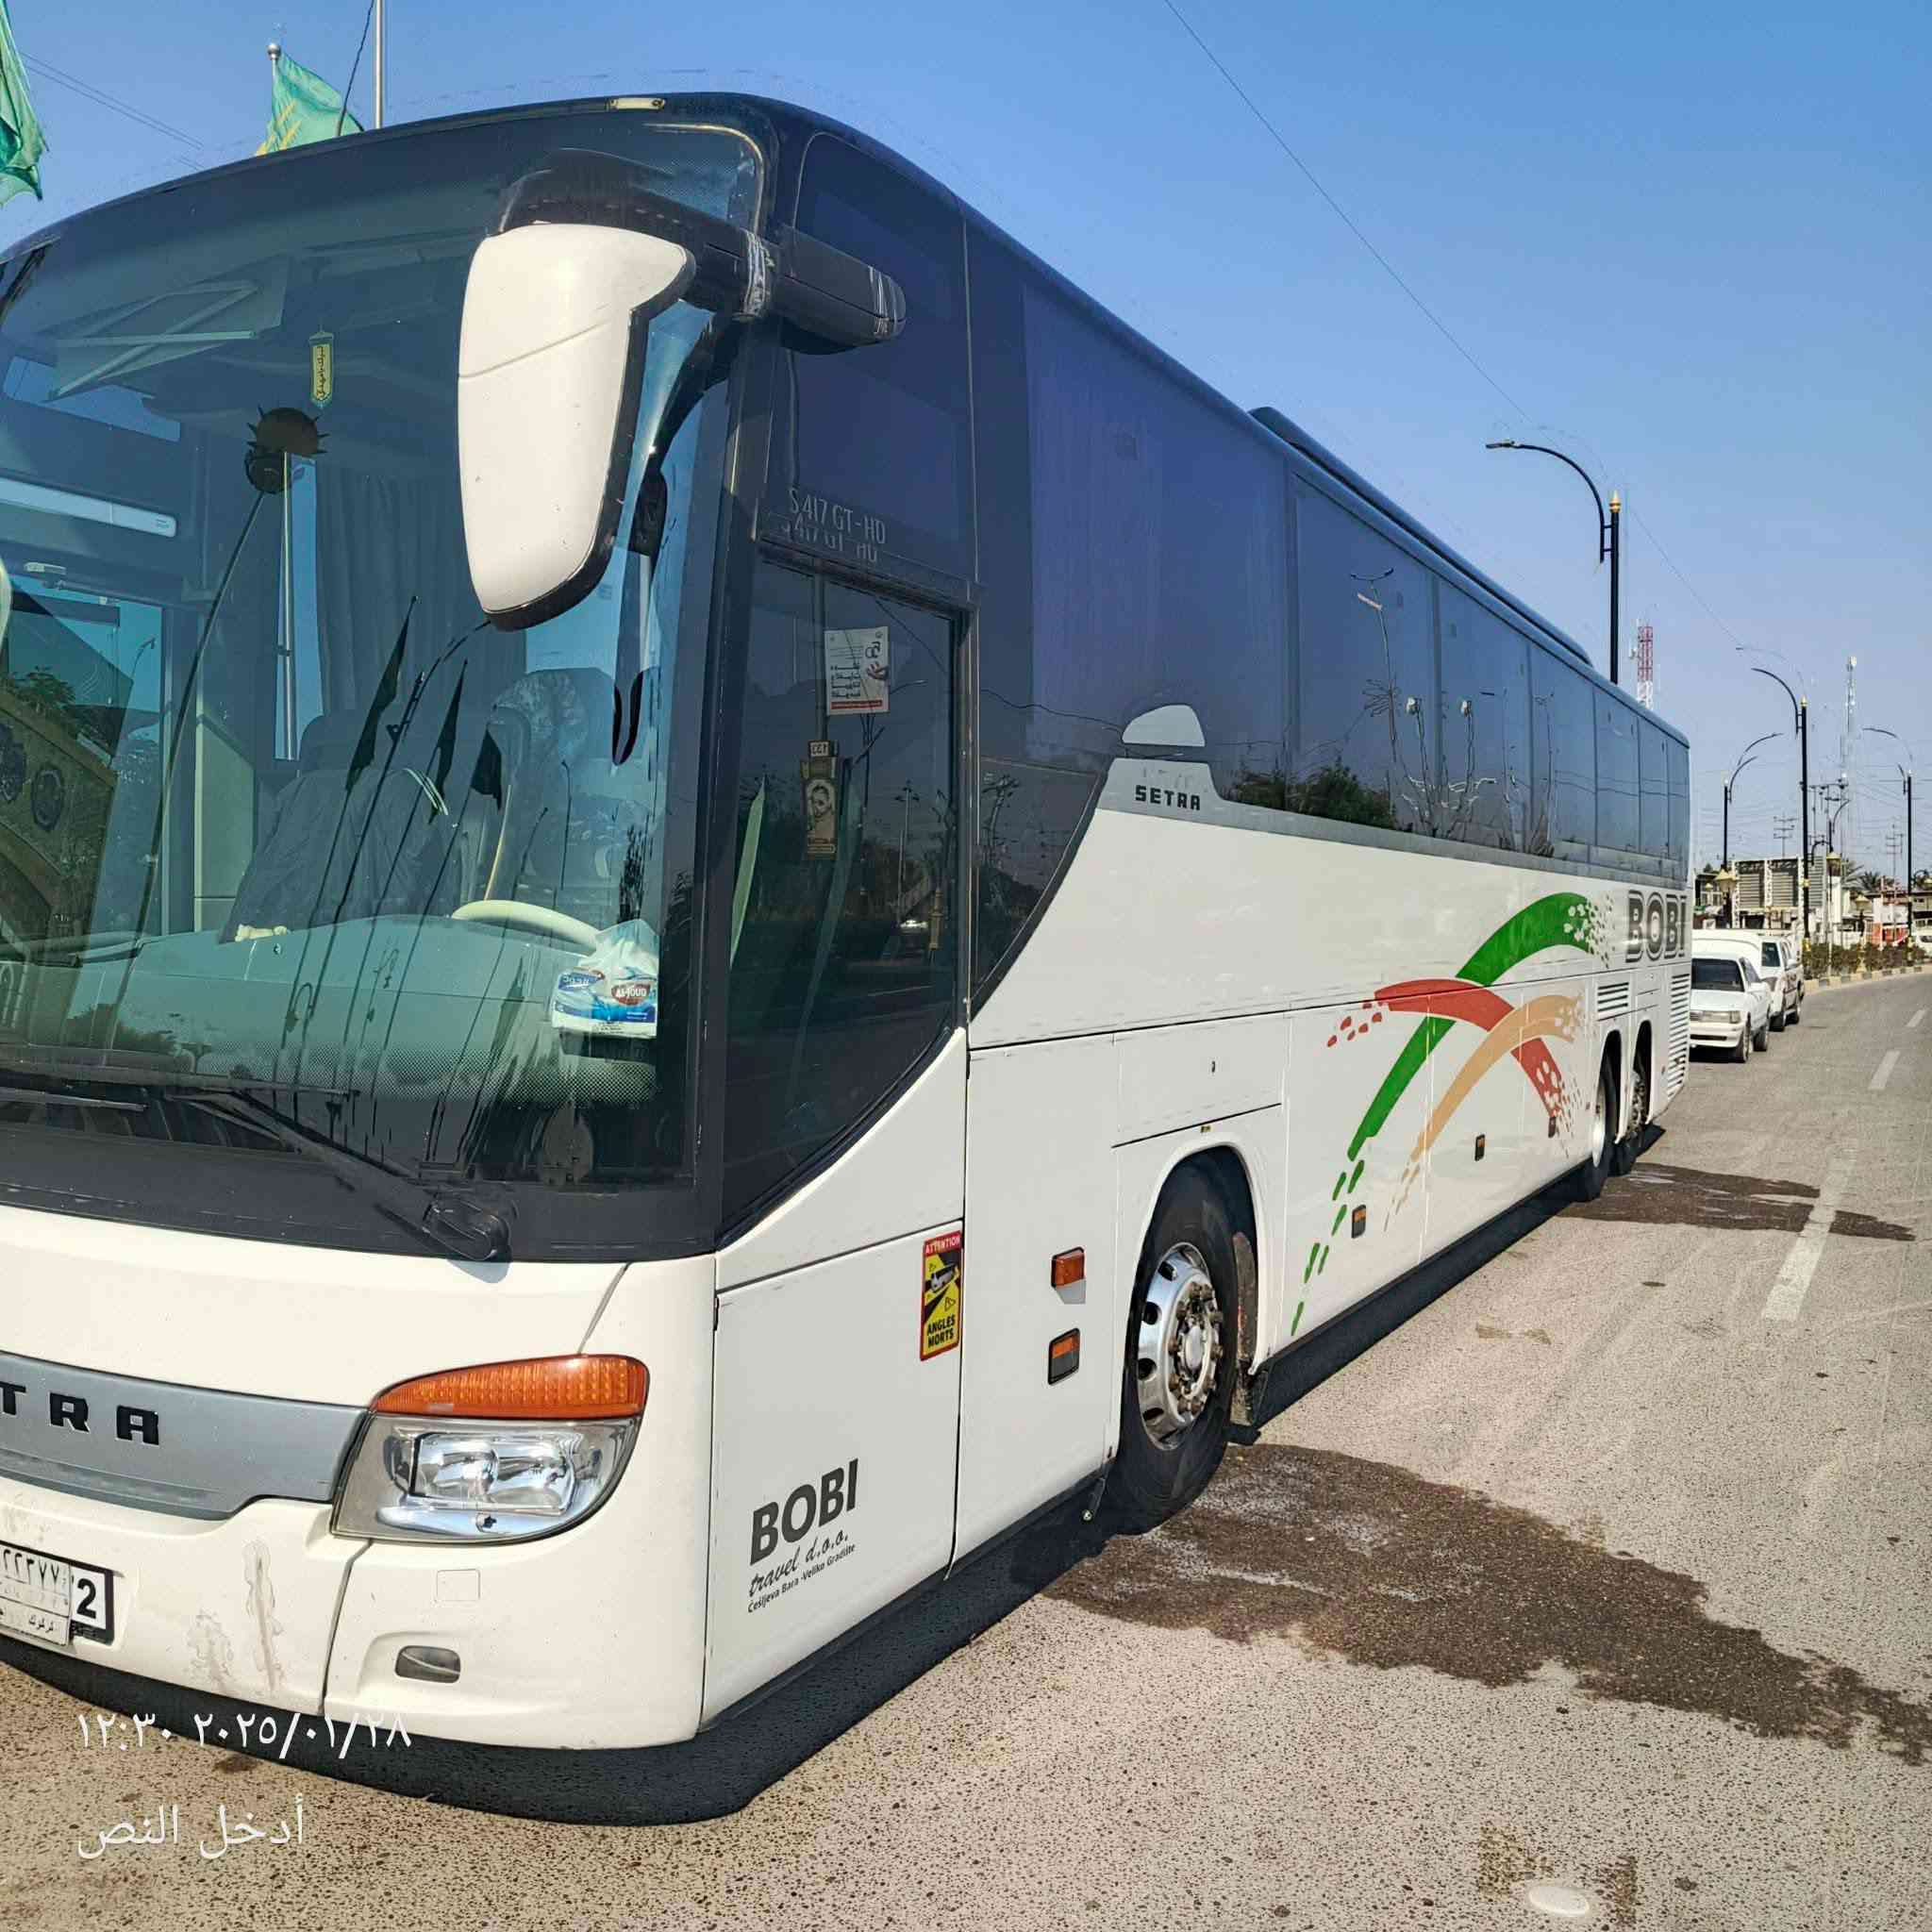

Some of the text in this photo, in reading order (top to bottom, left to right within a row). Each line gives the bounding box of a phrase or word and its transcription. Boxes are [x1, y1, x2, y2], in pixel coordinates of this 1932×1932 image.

[1135, 784, 1201, 811] SETRA
[1625, 890, 1688, 963] BOBI
[925, 1235, 961, 1255] ATTENTION
[926, 1313, 956, 1337] ANGLES
[927, 1326, 954, 1348] MORTS
[750, 1457, 858, 1567] BOBI
[748, 1544, 800, 1598] travel
[781, 1576, 799, 1593] Bara
